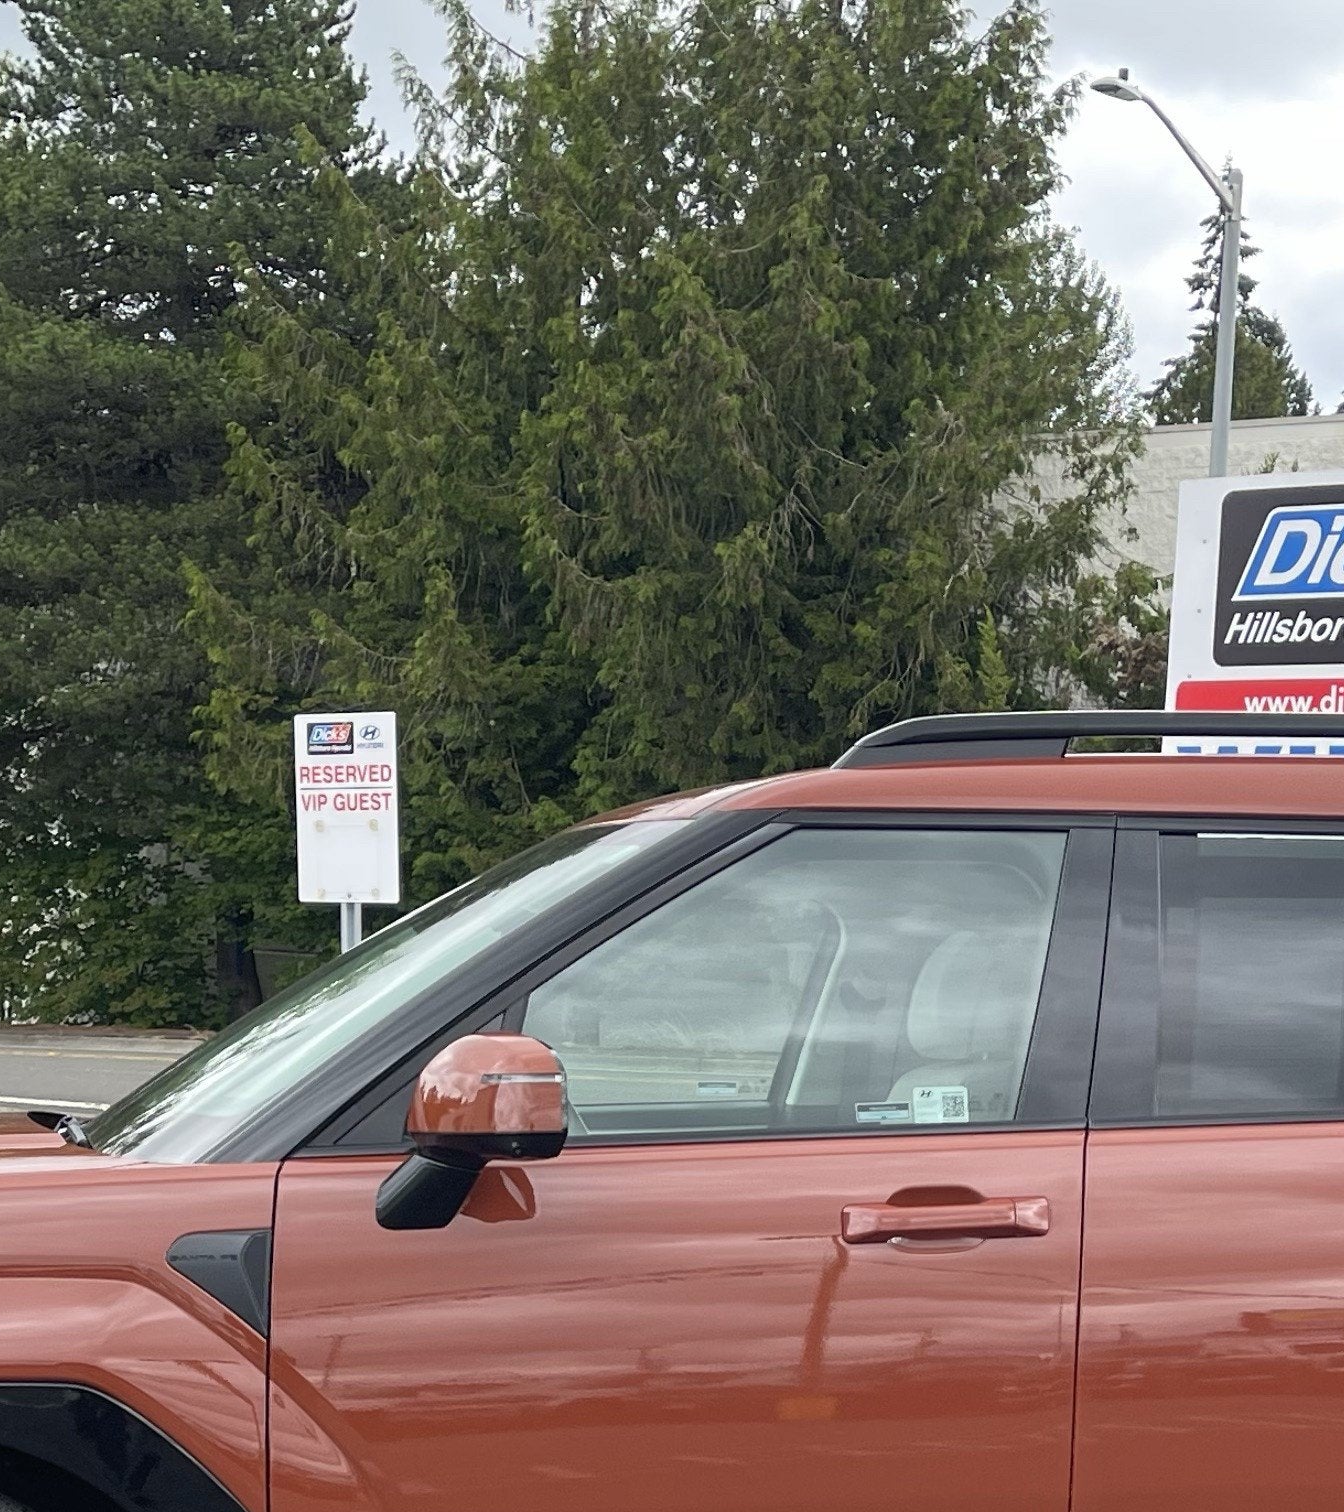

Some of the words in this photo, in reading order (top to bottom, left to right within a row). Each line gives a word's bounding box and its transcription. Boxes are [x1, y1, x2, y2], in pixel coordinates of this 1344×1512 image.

[299, 764, 392, 784] RESERVED
[301, 794, 328, 812] VIP
[333, 793, 392, 811] GUEST
